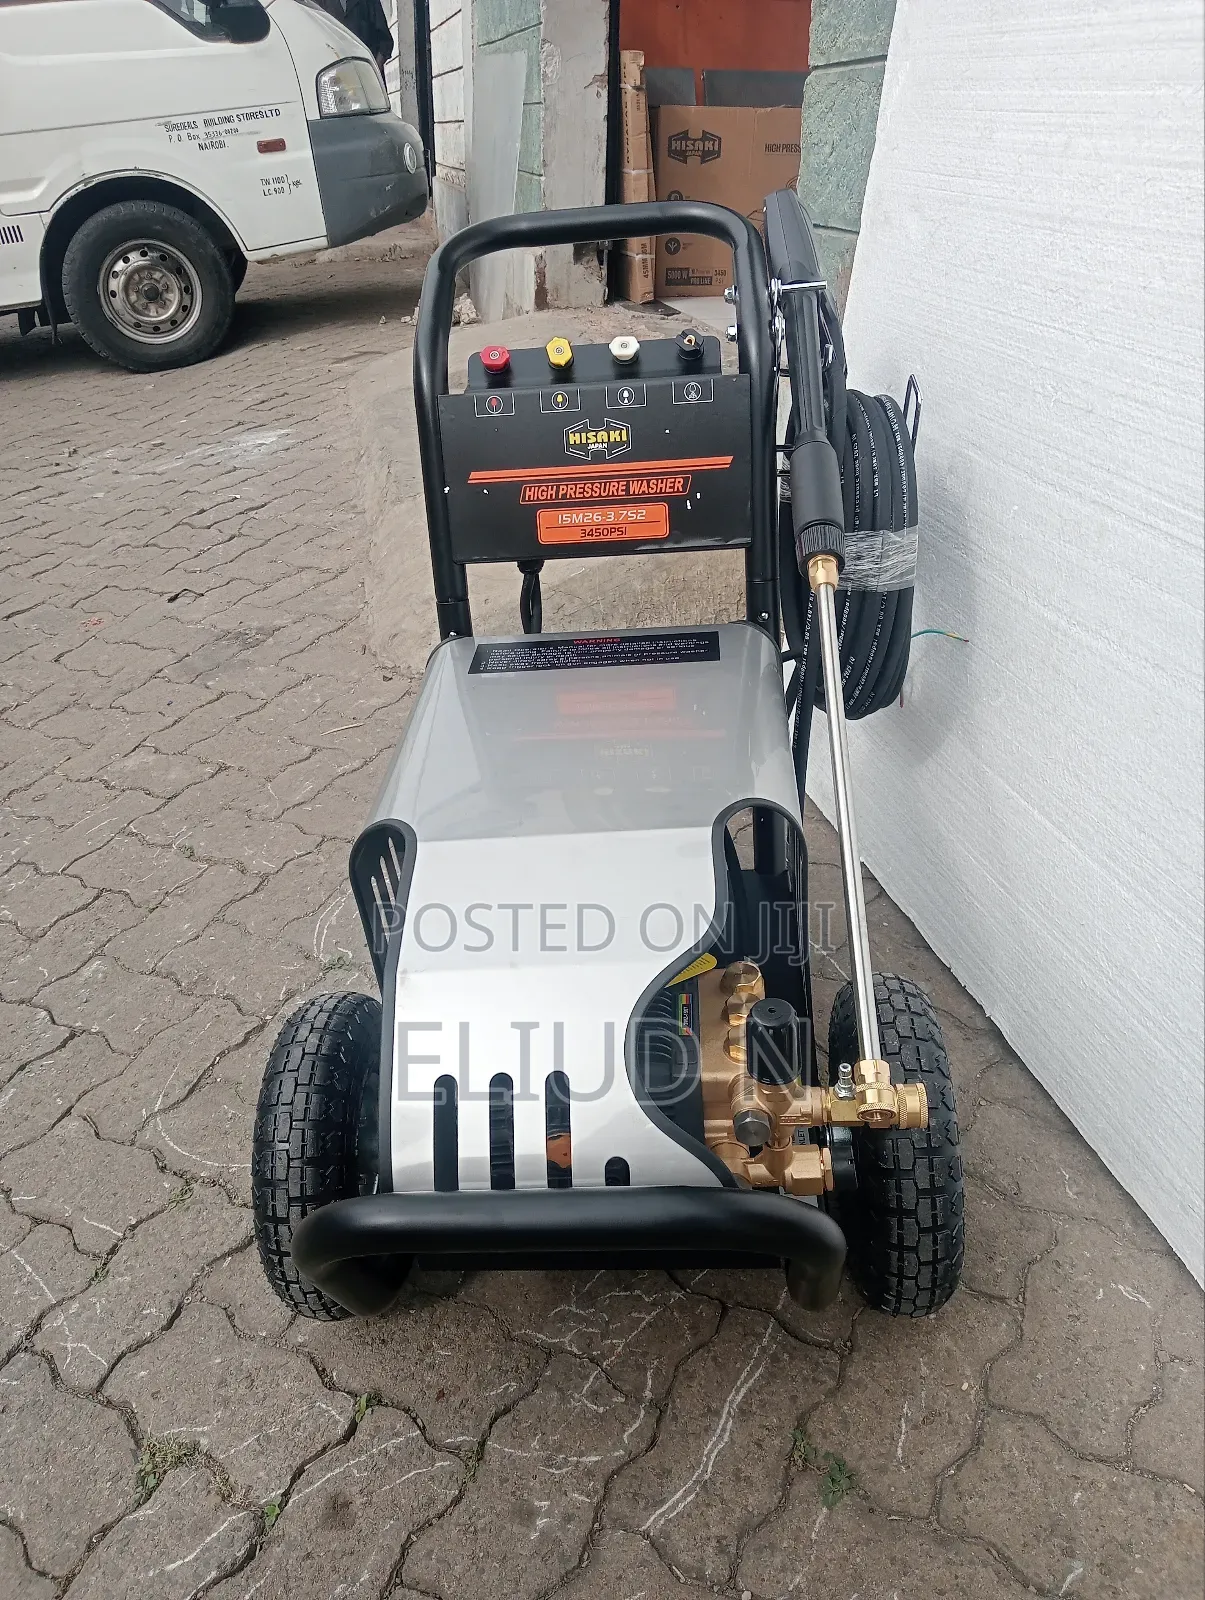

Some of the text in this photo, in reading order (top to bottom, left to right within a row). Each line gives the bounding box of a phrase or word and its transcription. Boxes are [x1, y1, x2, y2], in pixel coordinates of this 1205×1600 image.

[203, 114, 236, 128] BUILDING
[236, 110, 264, 122] STORES
[264, 108, 281, 117] LTD
[187, 131, 201, 141] Box
[671, 140, 719, 150] HISAKI
[765, 143, 801, 153] HIGH PRESS
[569, 429, 628, 444] HISAKI
[587, 442, 608, 450] JAPAN
[525, 477, 684, 501] HIGH PRESSURE WASHER
[580, 526, 627, 539] 3450PSI
